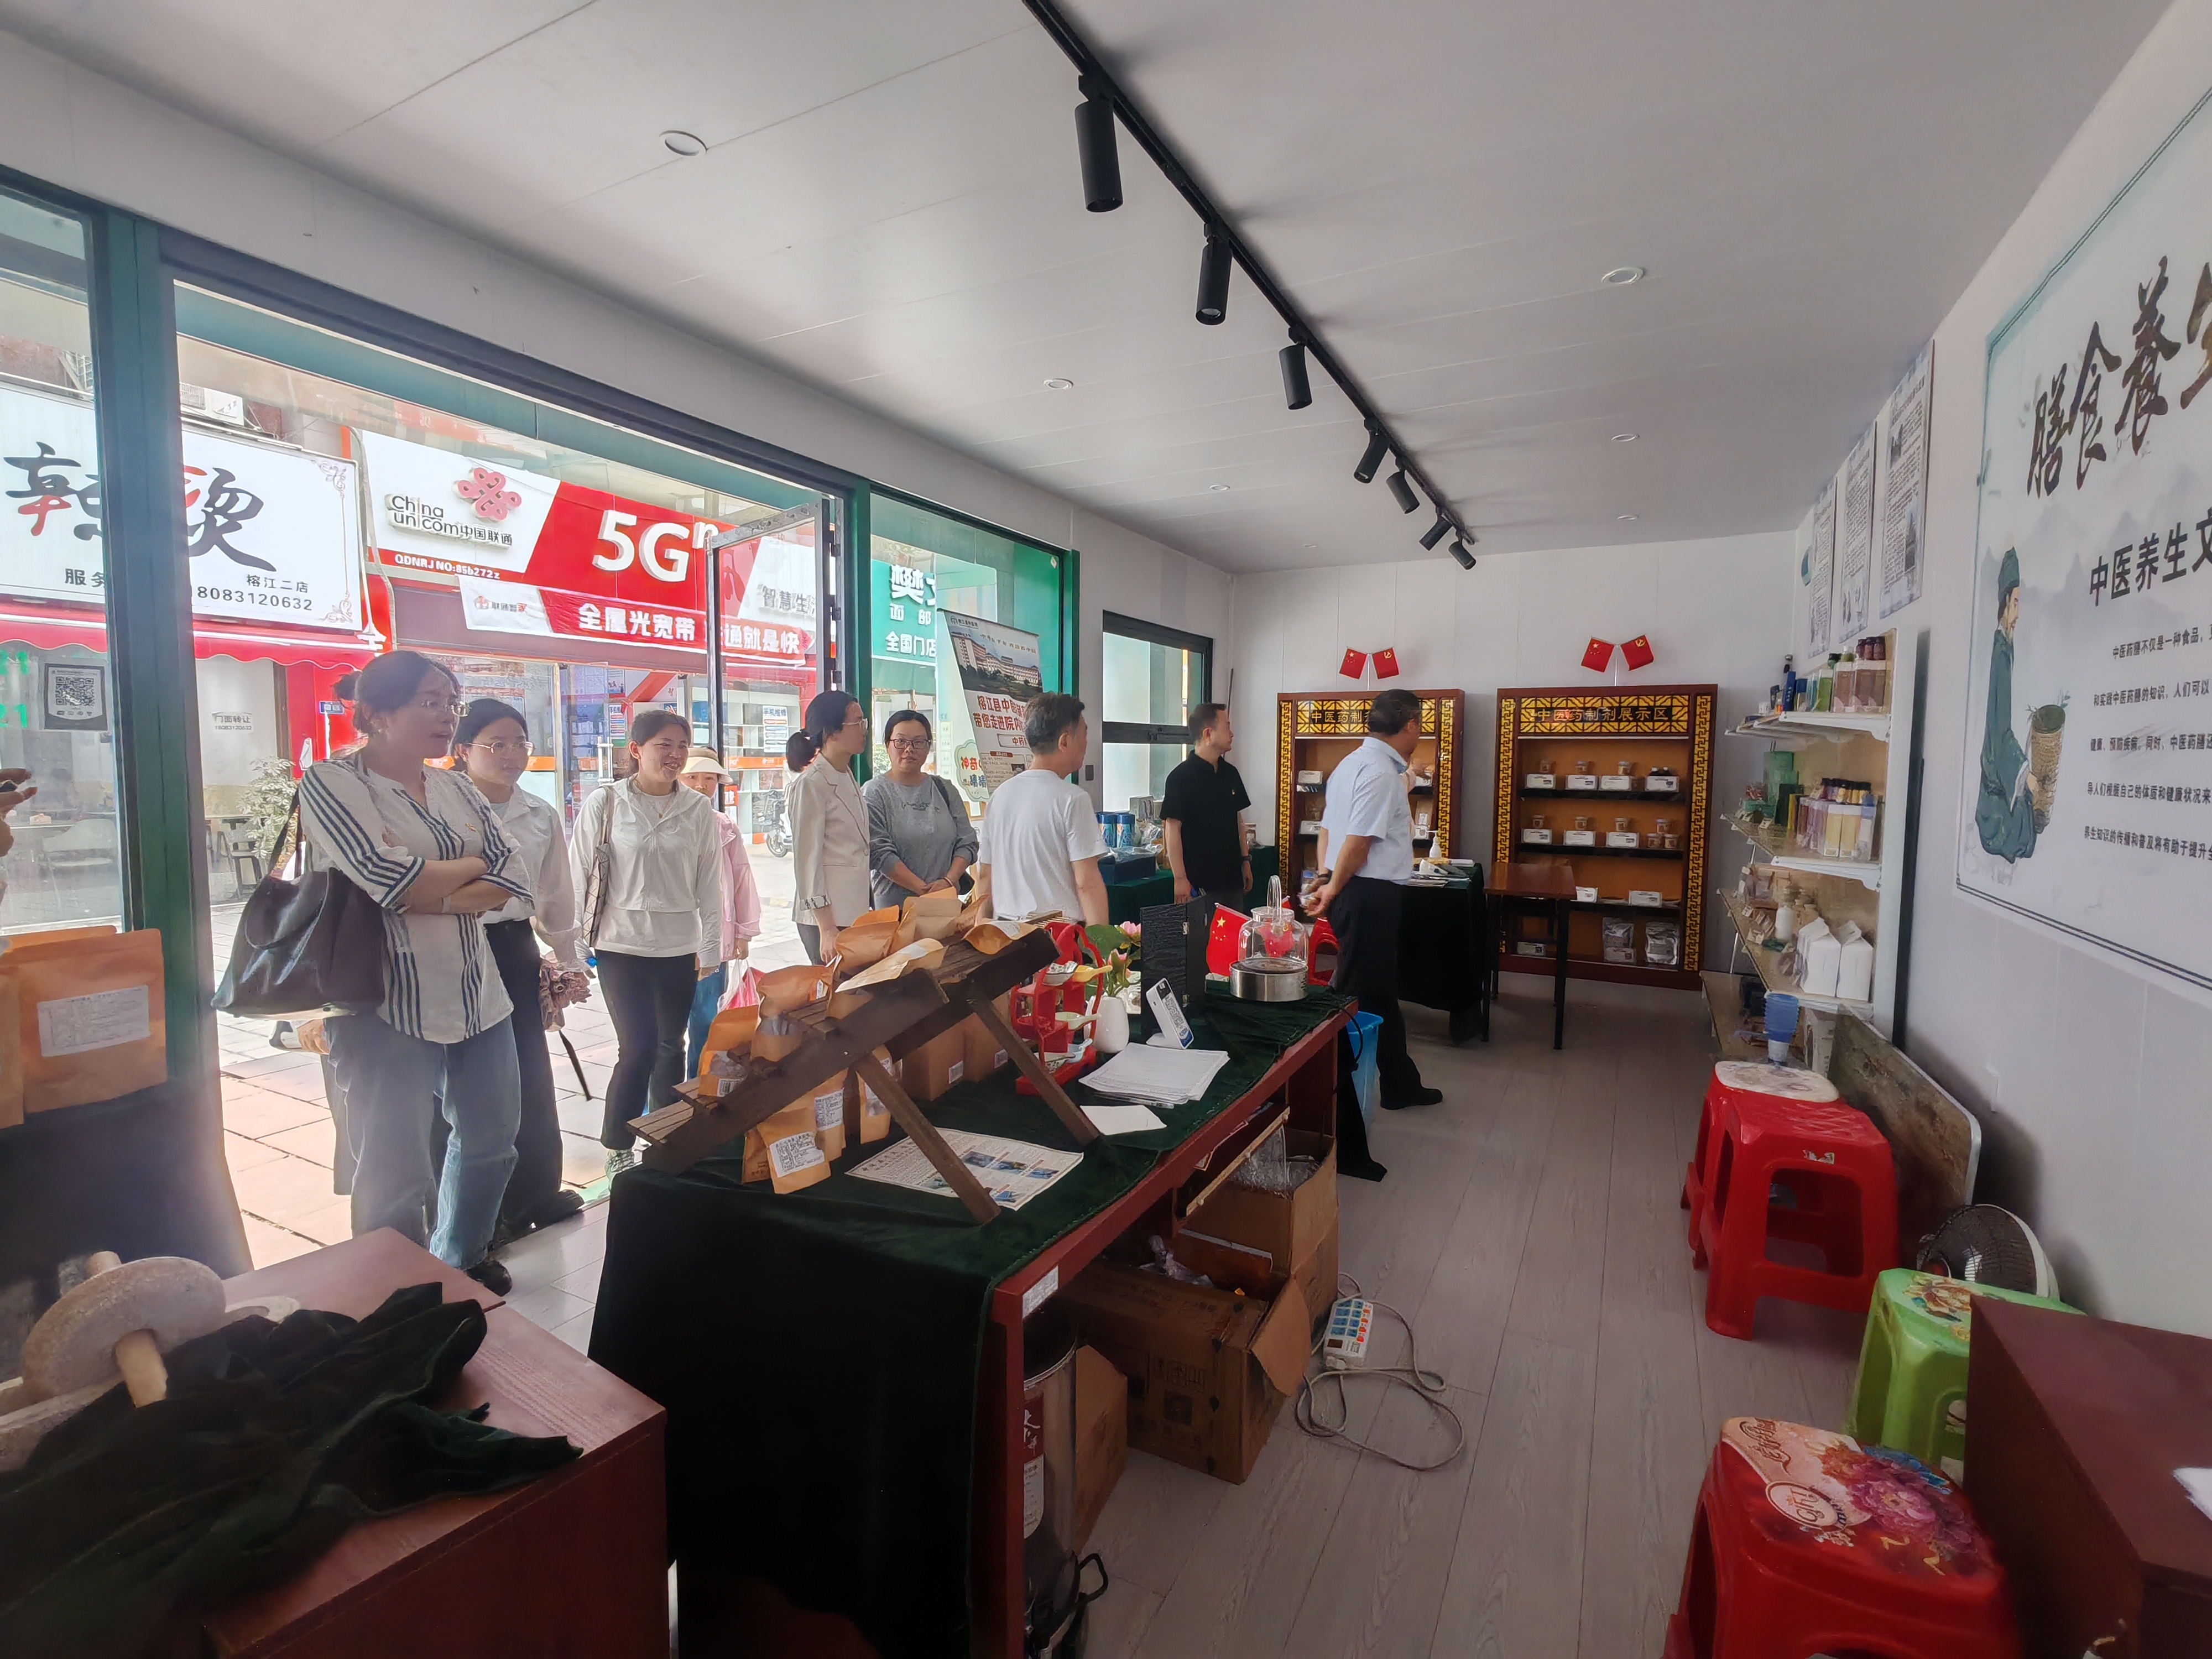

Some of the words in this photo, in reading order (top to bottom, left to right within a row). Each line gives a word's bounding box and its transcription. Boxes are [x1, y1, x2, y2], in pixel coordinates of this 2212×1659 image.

[392, 495, 444, 518] China
[394, 512, 459, 536] unicom
[460, 524, 513, 546] 中国联通
[2089, 506, 2212, 607] 中医养生文
[65, 568, 106, 588] 服务
[246, 574, 309, 593] 榕江二店
[191, 585, 313, 611] 8083120632
[889, 603, 932, 625] 面部
[721, 623, 800, 654] 通就是快
[885, 631, 936, 657] 全国门店
[1537, 707, 1668, 722] 中医药制剂展示区
[961, 756, 982, 770] 神奇
